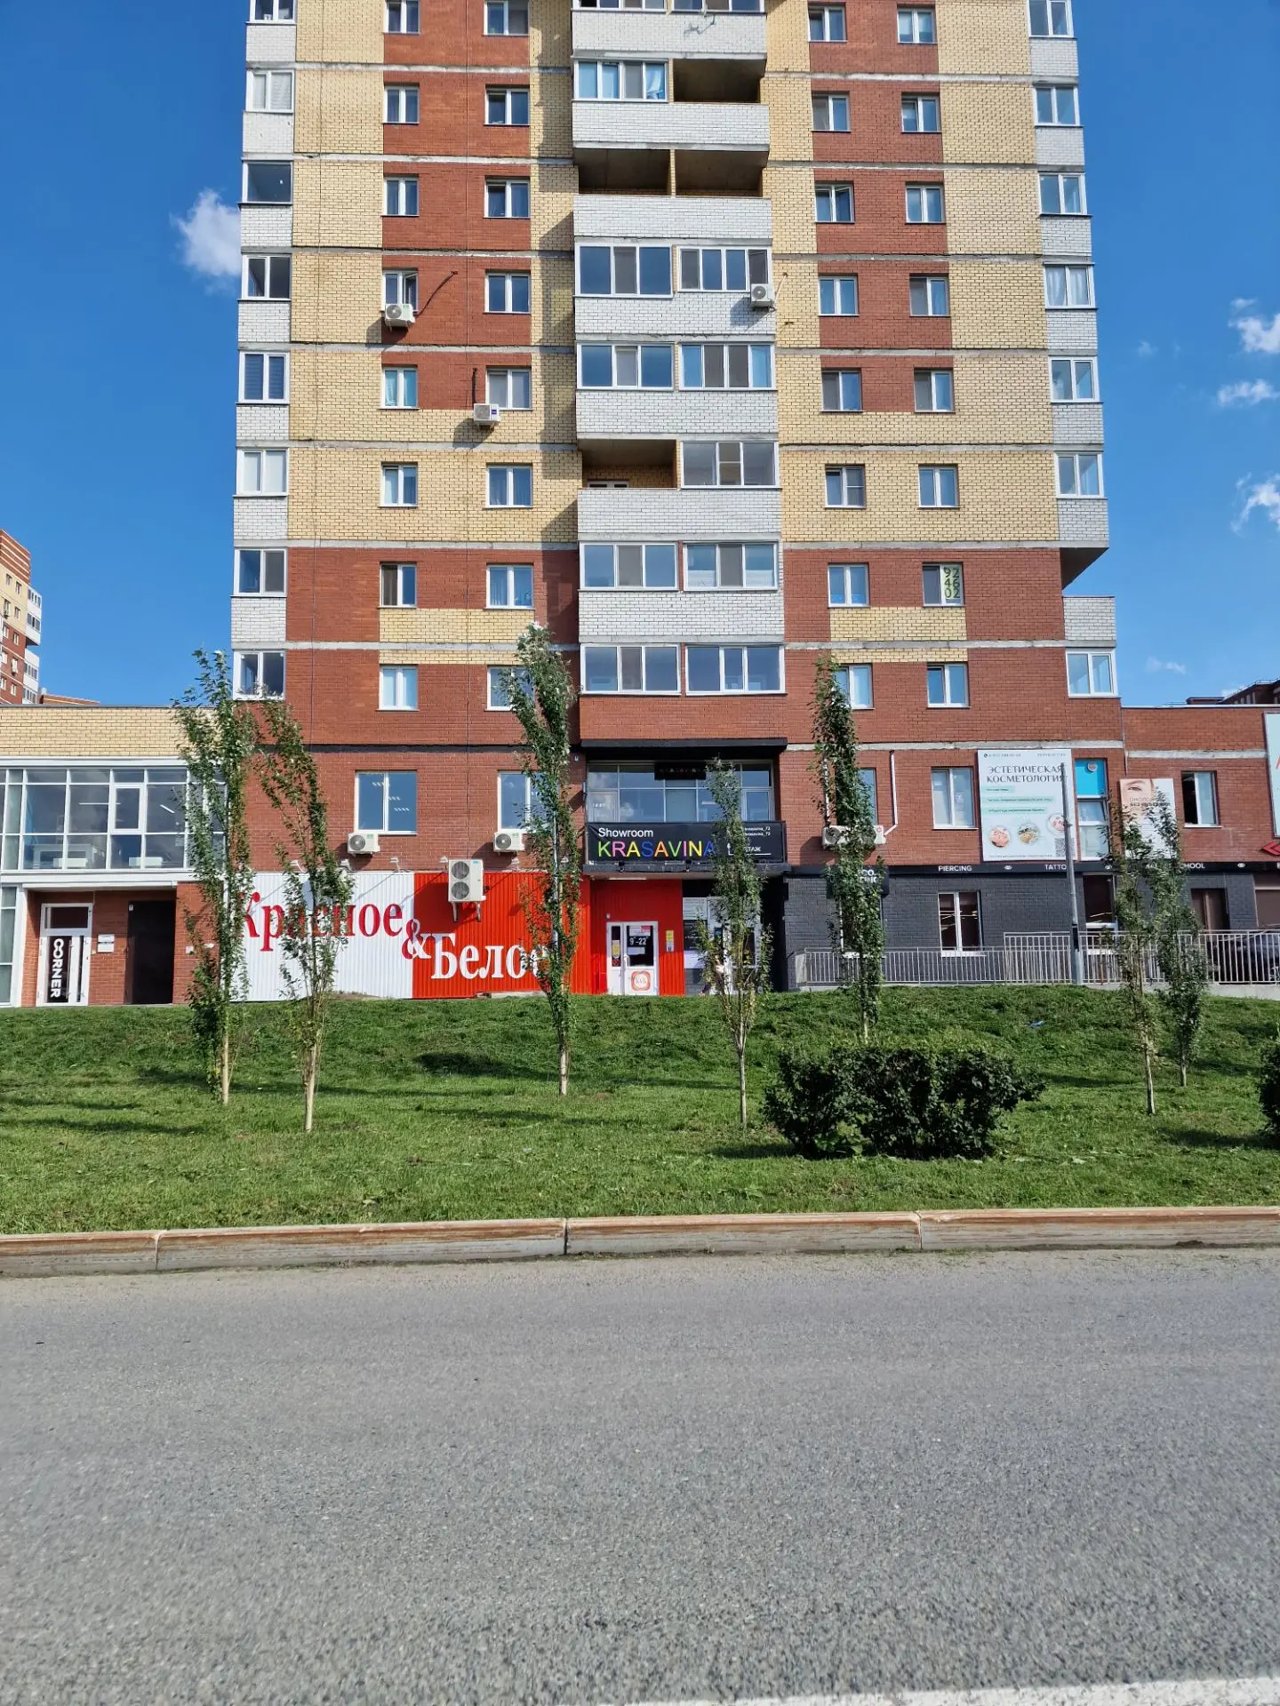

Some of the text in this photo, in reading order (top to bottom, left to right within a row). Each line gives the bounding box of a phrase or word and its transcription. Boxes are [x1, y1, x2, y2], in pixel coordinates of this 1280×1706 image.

[598, 827, 654, 838] Showroom
[598, 841, 716, 857] KRASAVINA
[50, 938, 65, 998] CORNER
